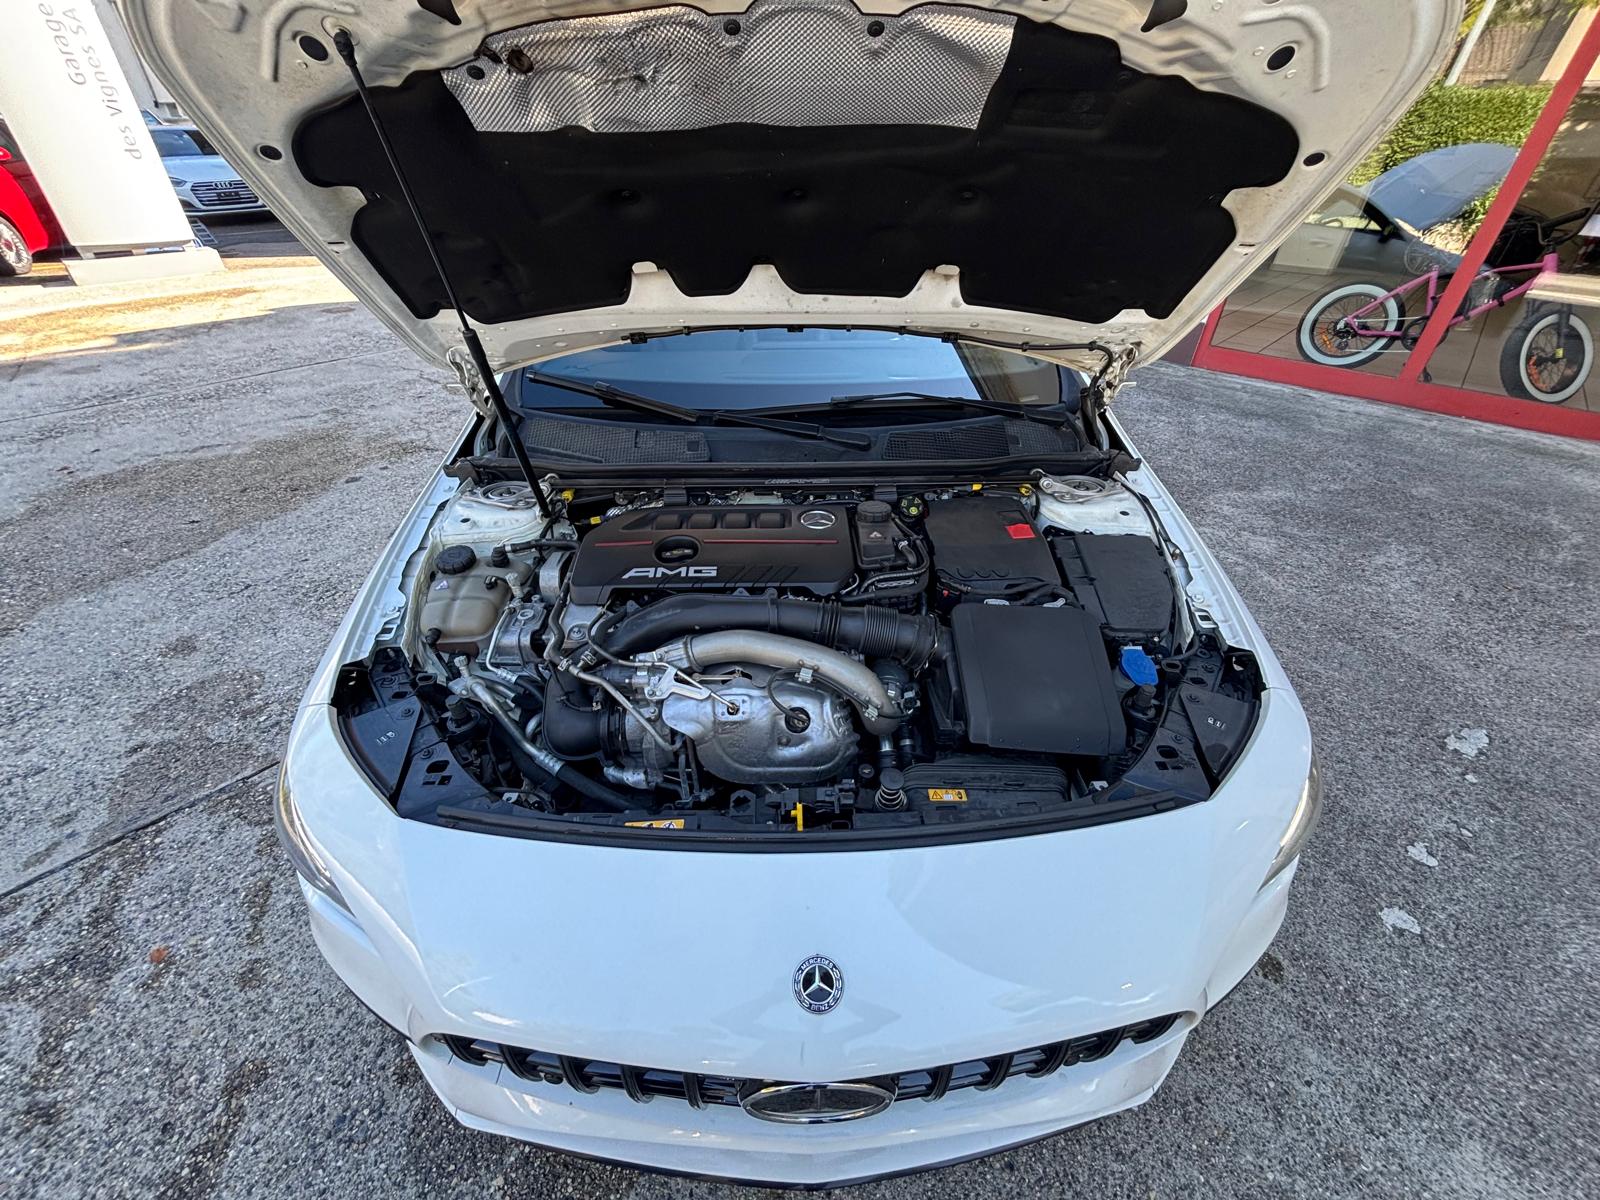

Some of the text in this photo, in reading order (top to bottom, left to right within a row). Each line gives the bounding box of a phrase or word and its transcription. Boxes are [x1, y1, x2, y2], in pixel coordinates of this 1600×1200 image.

[38, 2, 87, 86] Garage
[62, 8, 143, 160] des vignes SA
[622, 566, 718, 579] AMG
[801, 957, 833, 970] MERCEDES
[810, 1003, 829, 1011] BENZ
